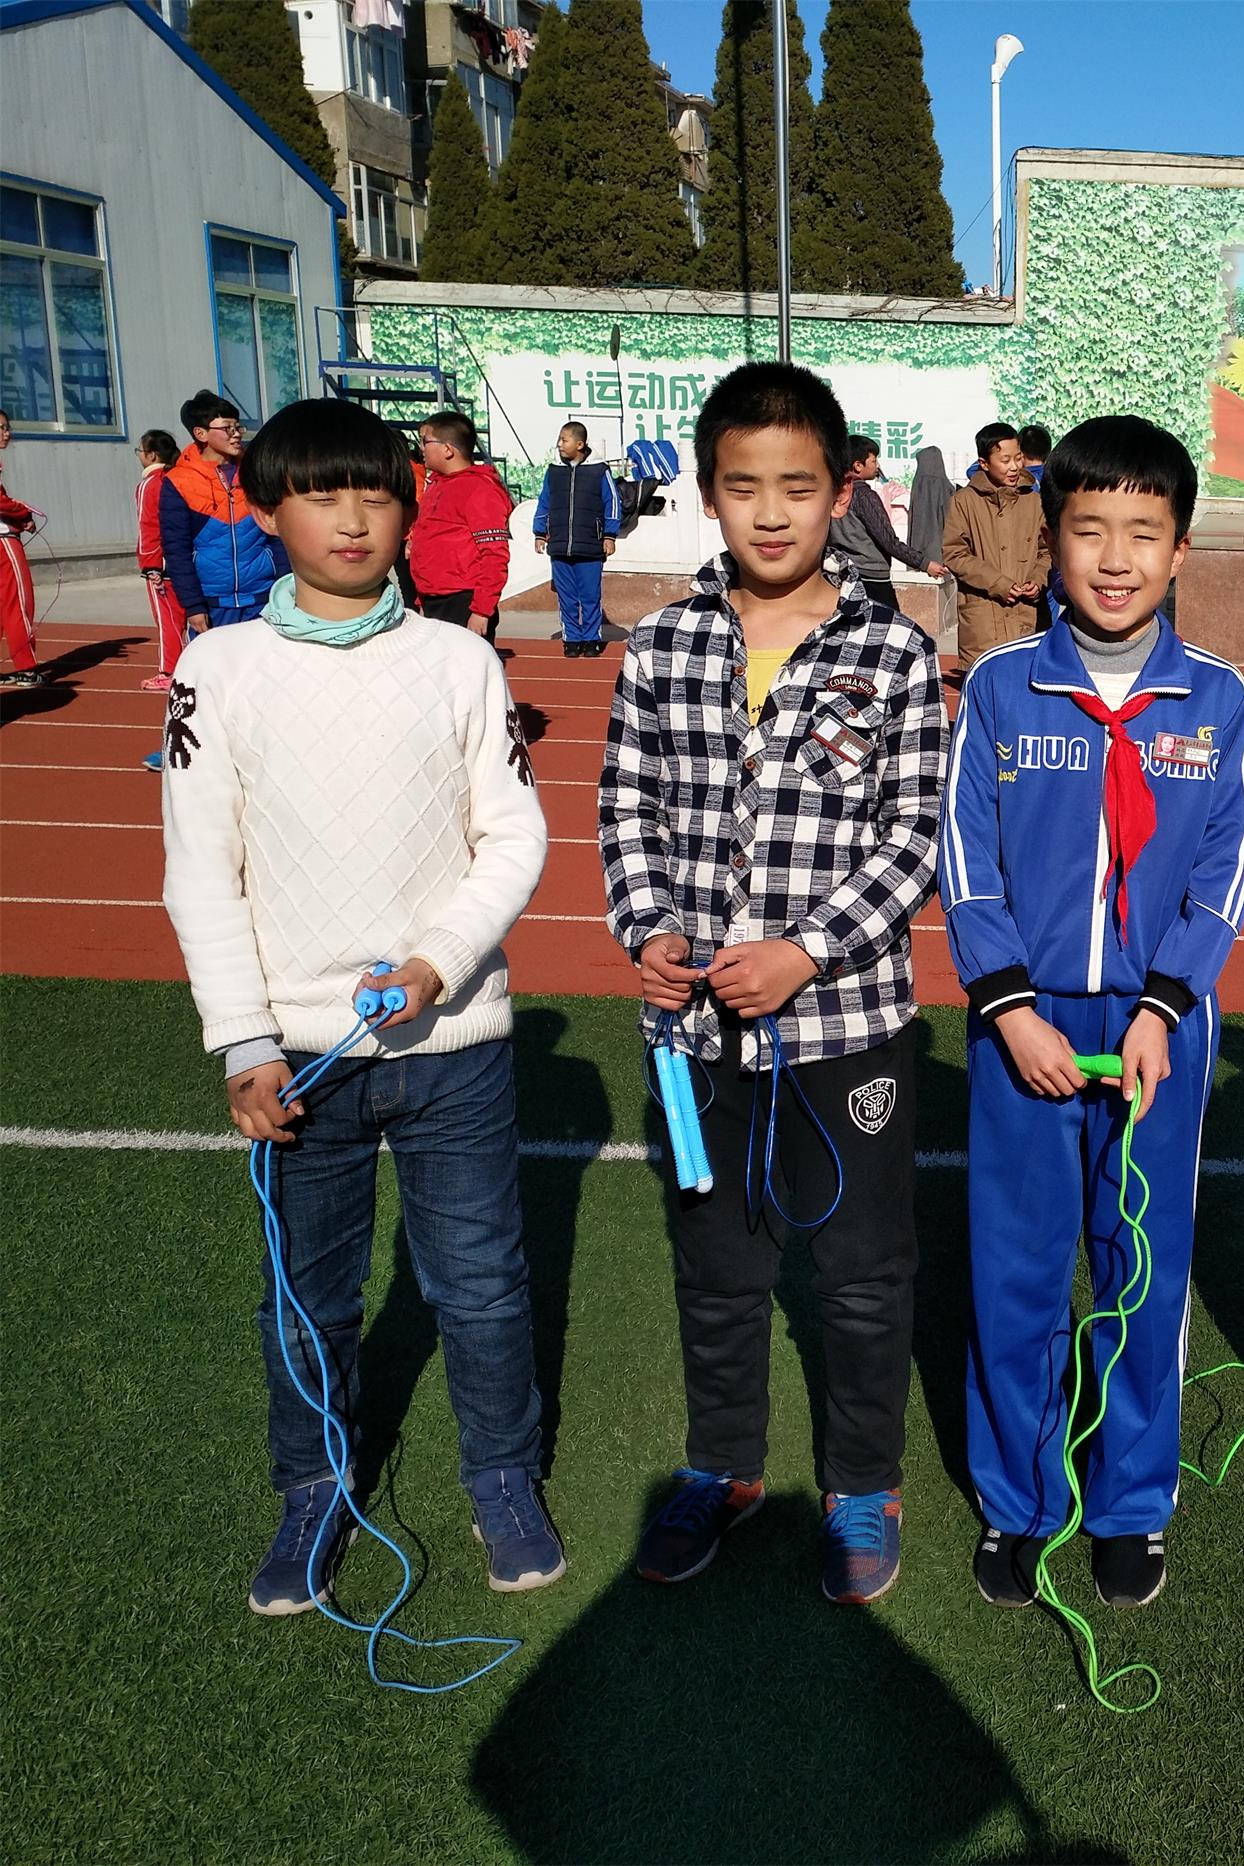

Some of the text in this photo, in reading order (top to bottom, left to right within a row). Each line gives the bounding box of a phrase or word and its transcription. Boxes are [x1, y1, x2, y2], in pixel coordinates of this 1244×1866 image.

[543, 369, 722, 411] 让运动成
[1017, 734, 1090, 771] HUA
[854, 1080, 892, 1100] POLICE
